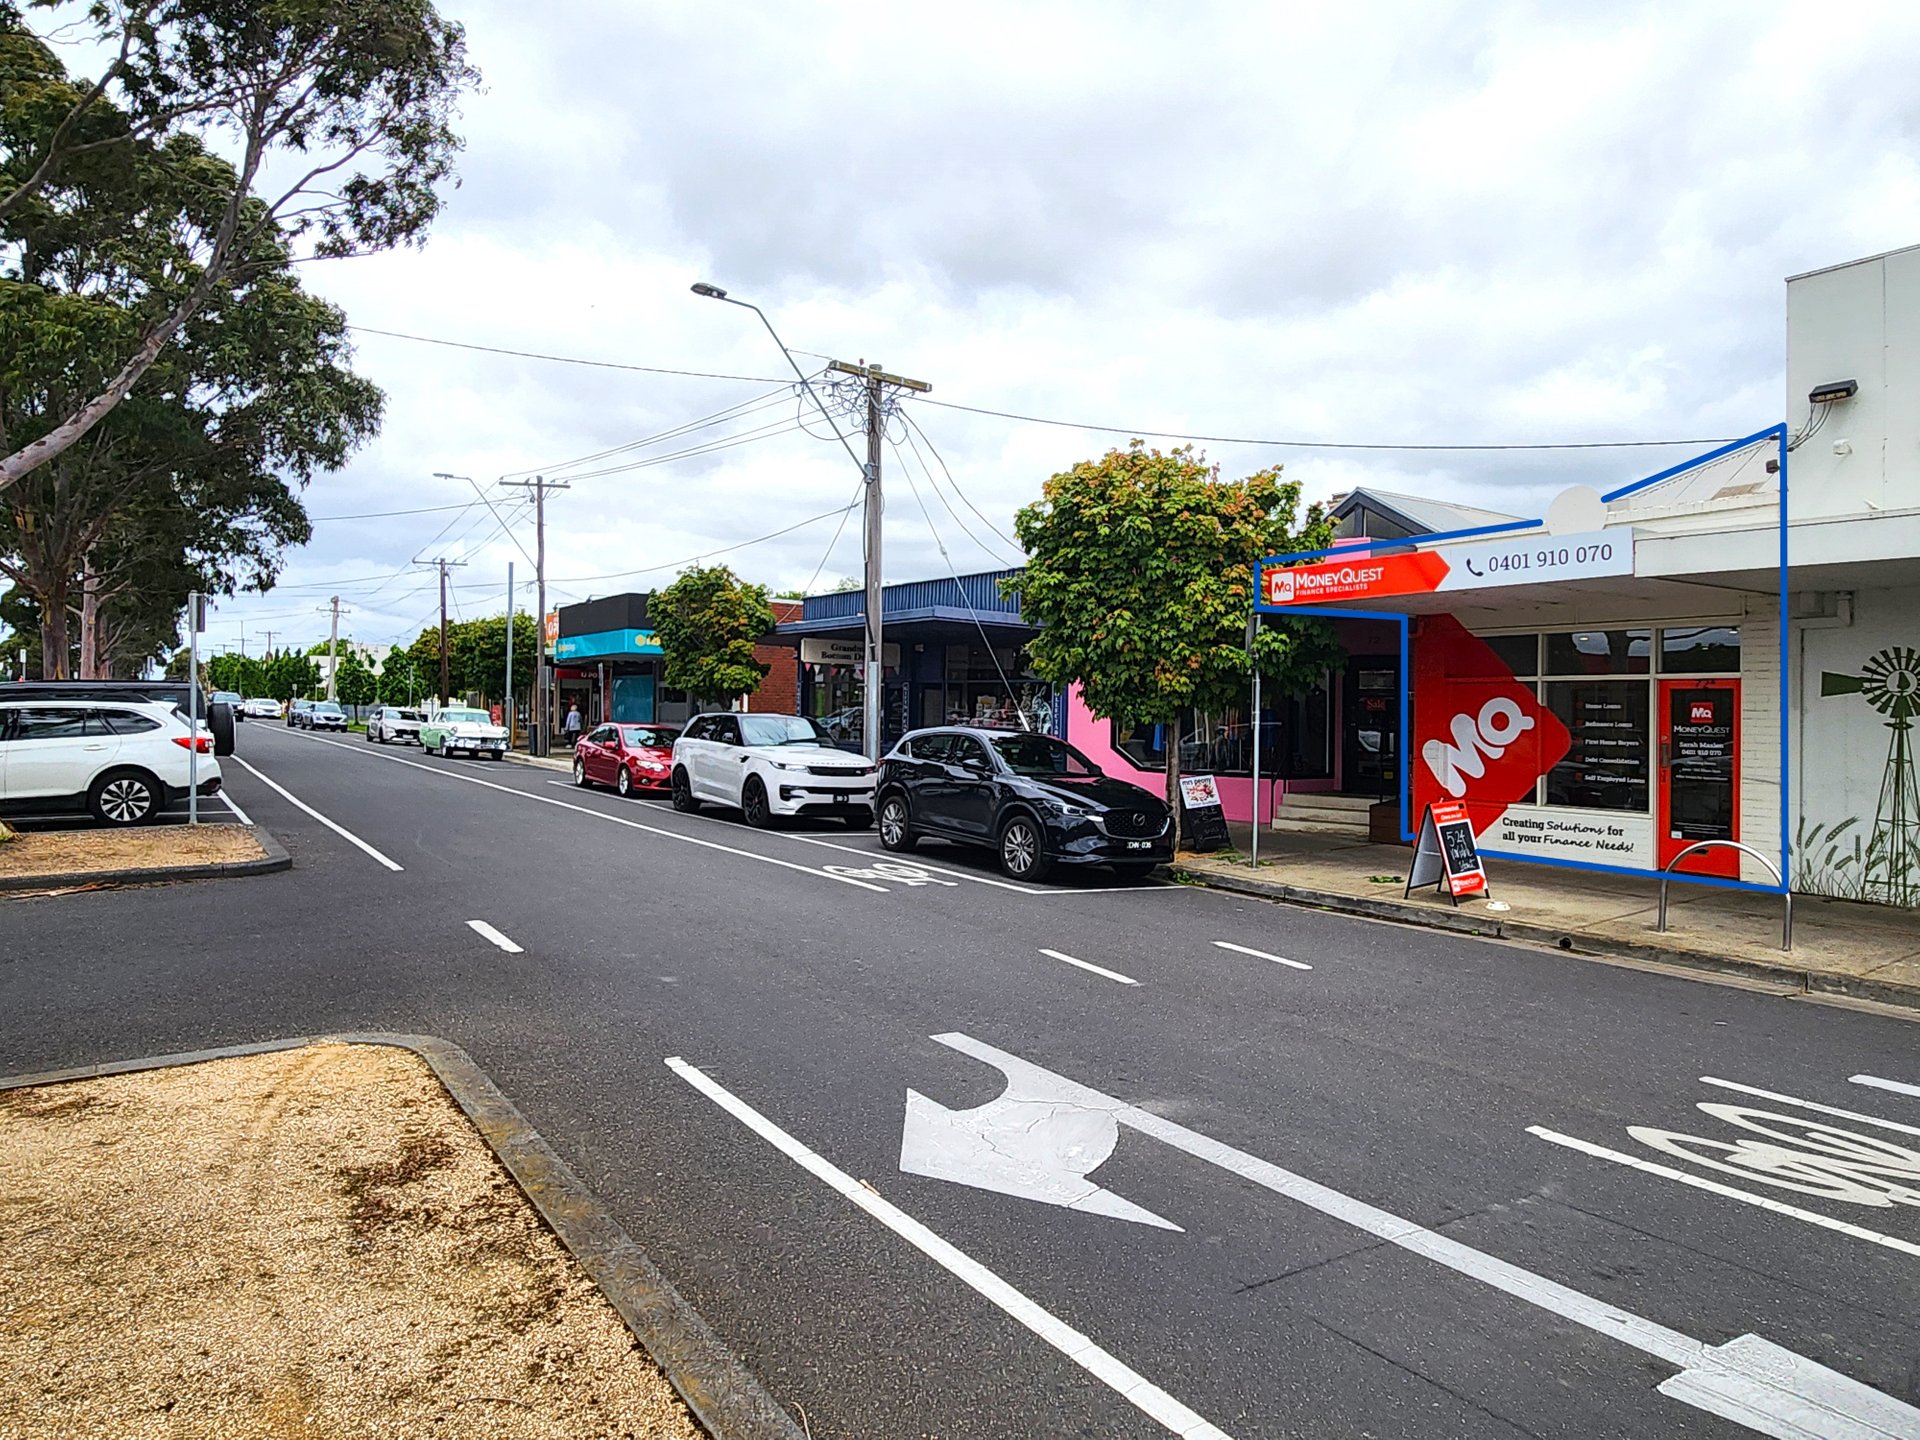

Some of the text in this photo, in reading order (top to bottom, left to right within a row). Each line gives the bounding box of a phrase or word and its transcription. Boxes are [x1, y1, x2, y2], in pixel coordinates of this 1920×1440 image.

[1489, 544, 1613, 573] 0401 910 070
[1296, 584, 1368, 596] FINANCE SPECIALISTS
[1422, 697, 1535, 798] MQ
[1502, 817, 1624, 836] Creating Solutions for
[1502, 832, 1634, 853] all your Finance Needs!
